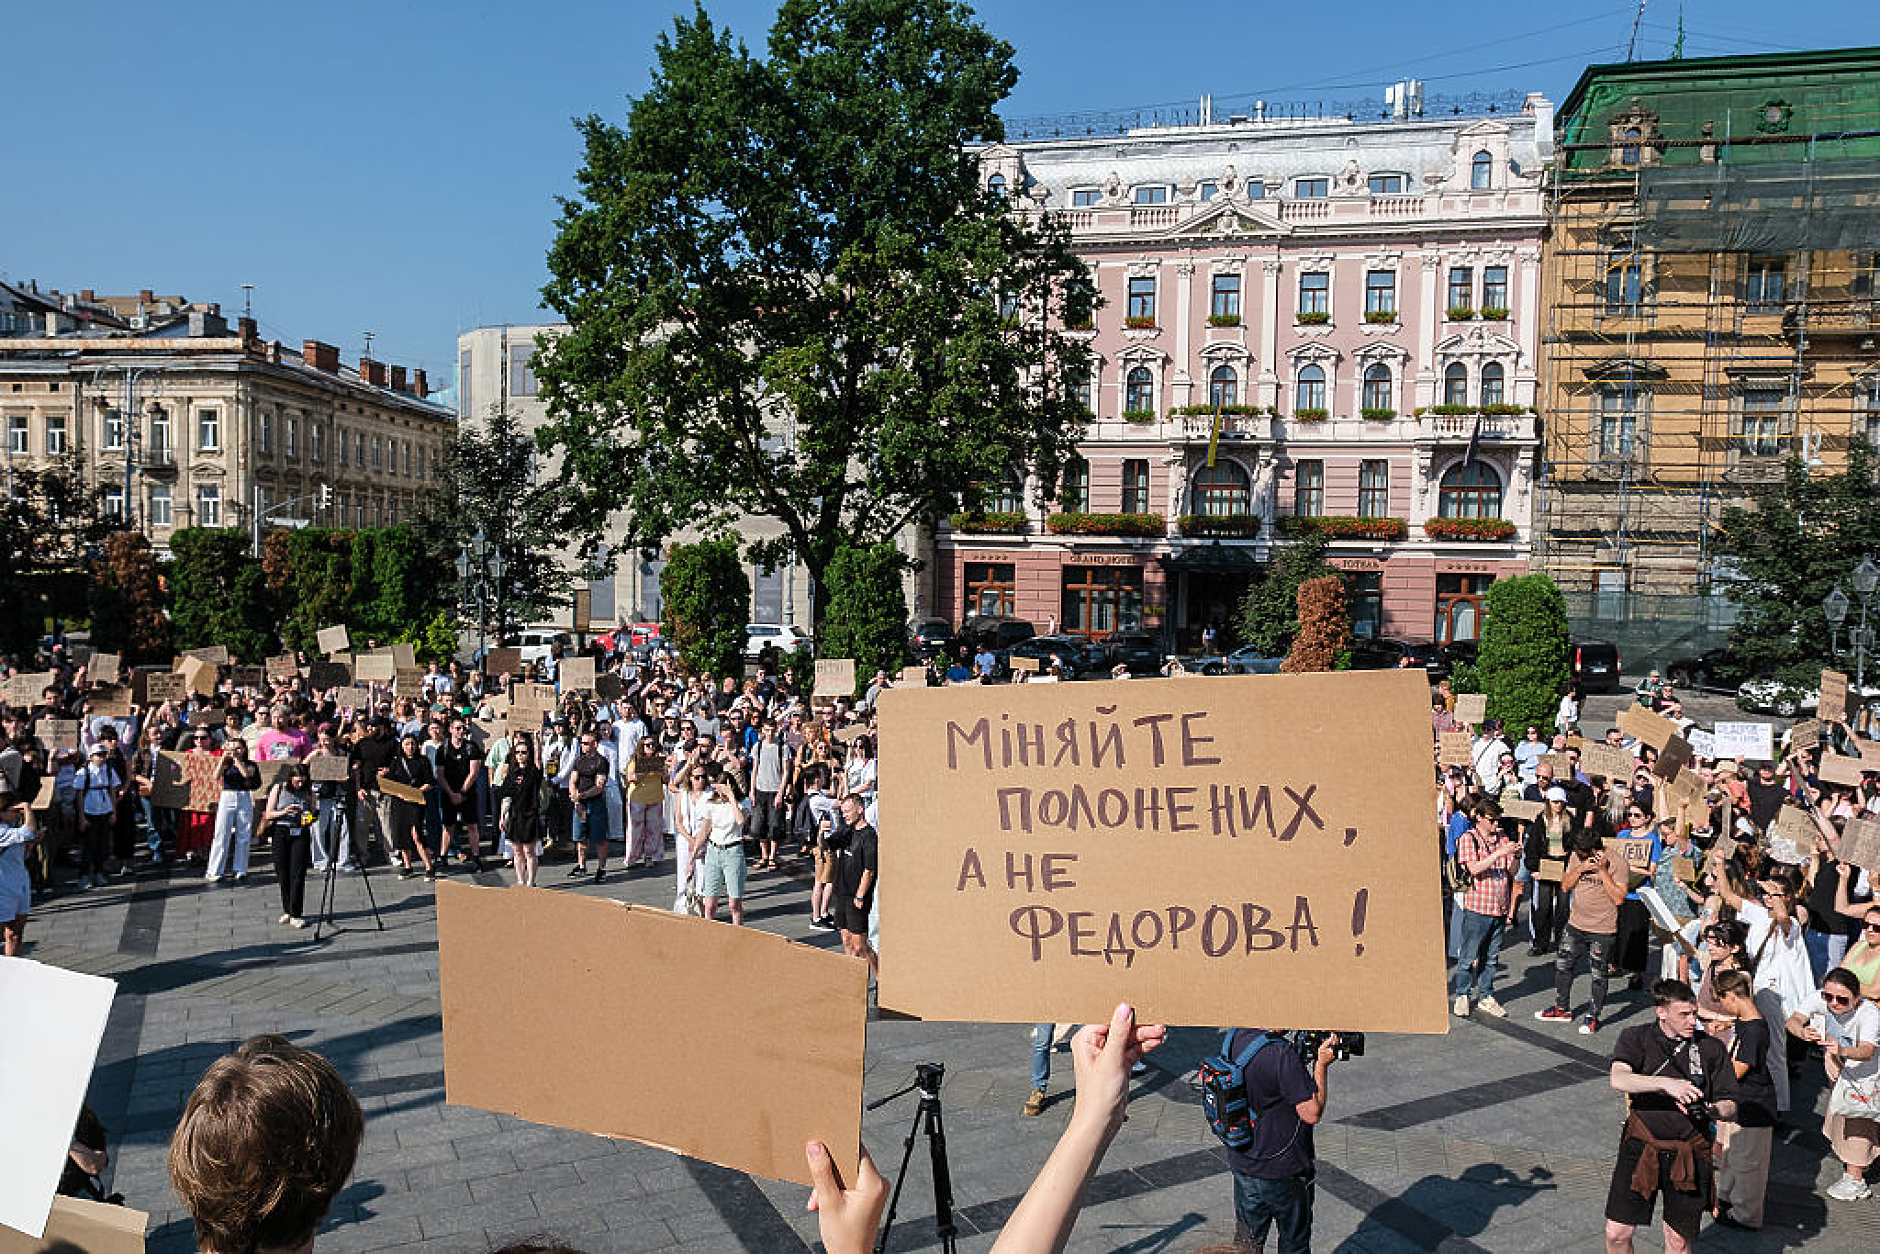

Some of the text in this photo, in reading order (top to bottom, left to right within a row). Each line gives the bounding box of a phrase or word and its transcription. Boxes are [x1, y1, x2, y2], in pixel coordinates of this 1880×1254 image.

[997, 783, 1358, 847] ПОЛОНЕНИХ,
[956, 848, 1078, 893] А НЕ
